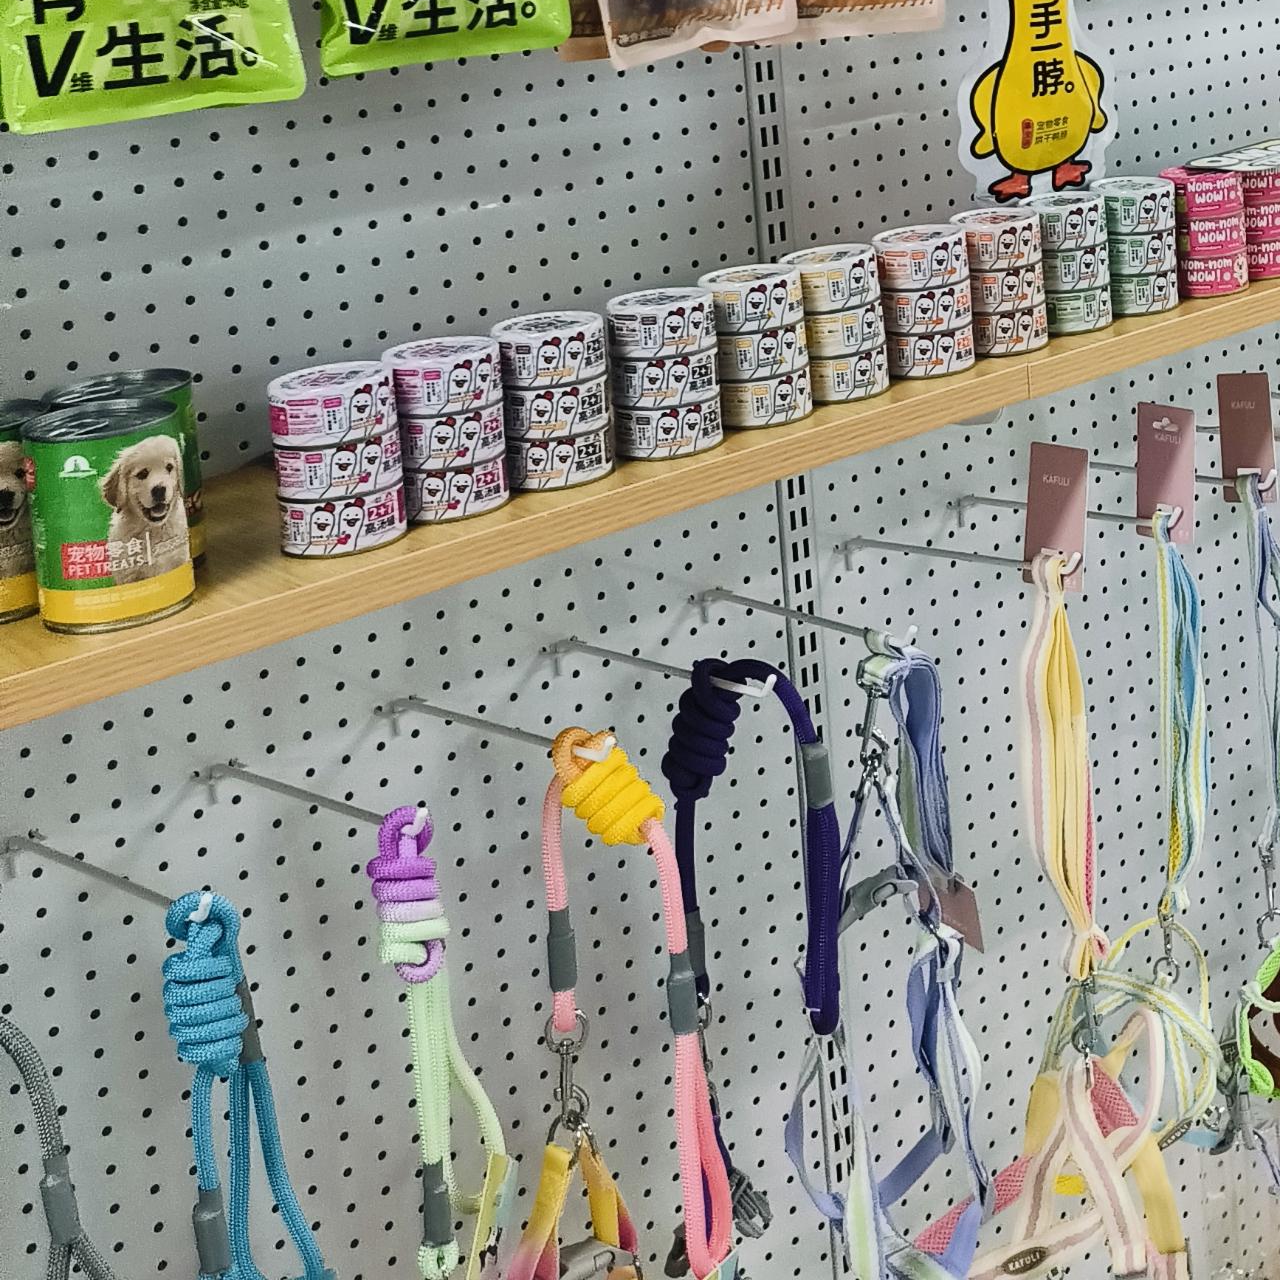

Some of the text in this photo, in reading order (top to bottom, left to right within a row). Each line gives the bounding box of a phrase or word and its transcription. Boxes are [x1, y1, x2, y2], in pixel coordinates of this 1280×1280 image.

[1187, 176, 1237, 193] Nom-nom
[1194, 188, 1227, 204] WOW!
[1190, 215, 1239, 232] Nom-nom
[1198, 228, 1230, 243] WOW!
[1181, 256, 1232, 271] Nom-nom
[1187, 267, 1220, 282] WOW!
[577, 443, 602, 459] 2+7
[475, 471, 500, 487] 2+7
[1042, 473, 1071, 487] KAFULI
[368, 501, 394, 521] 2+7
[68, 538, 143, 563] 宠物零食
[69, 555, 145, 577] PET TREATS
